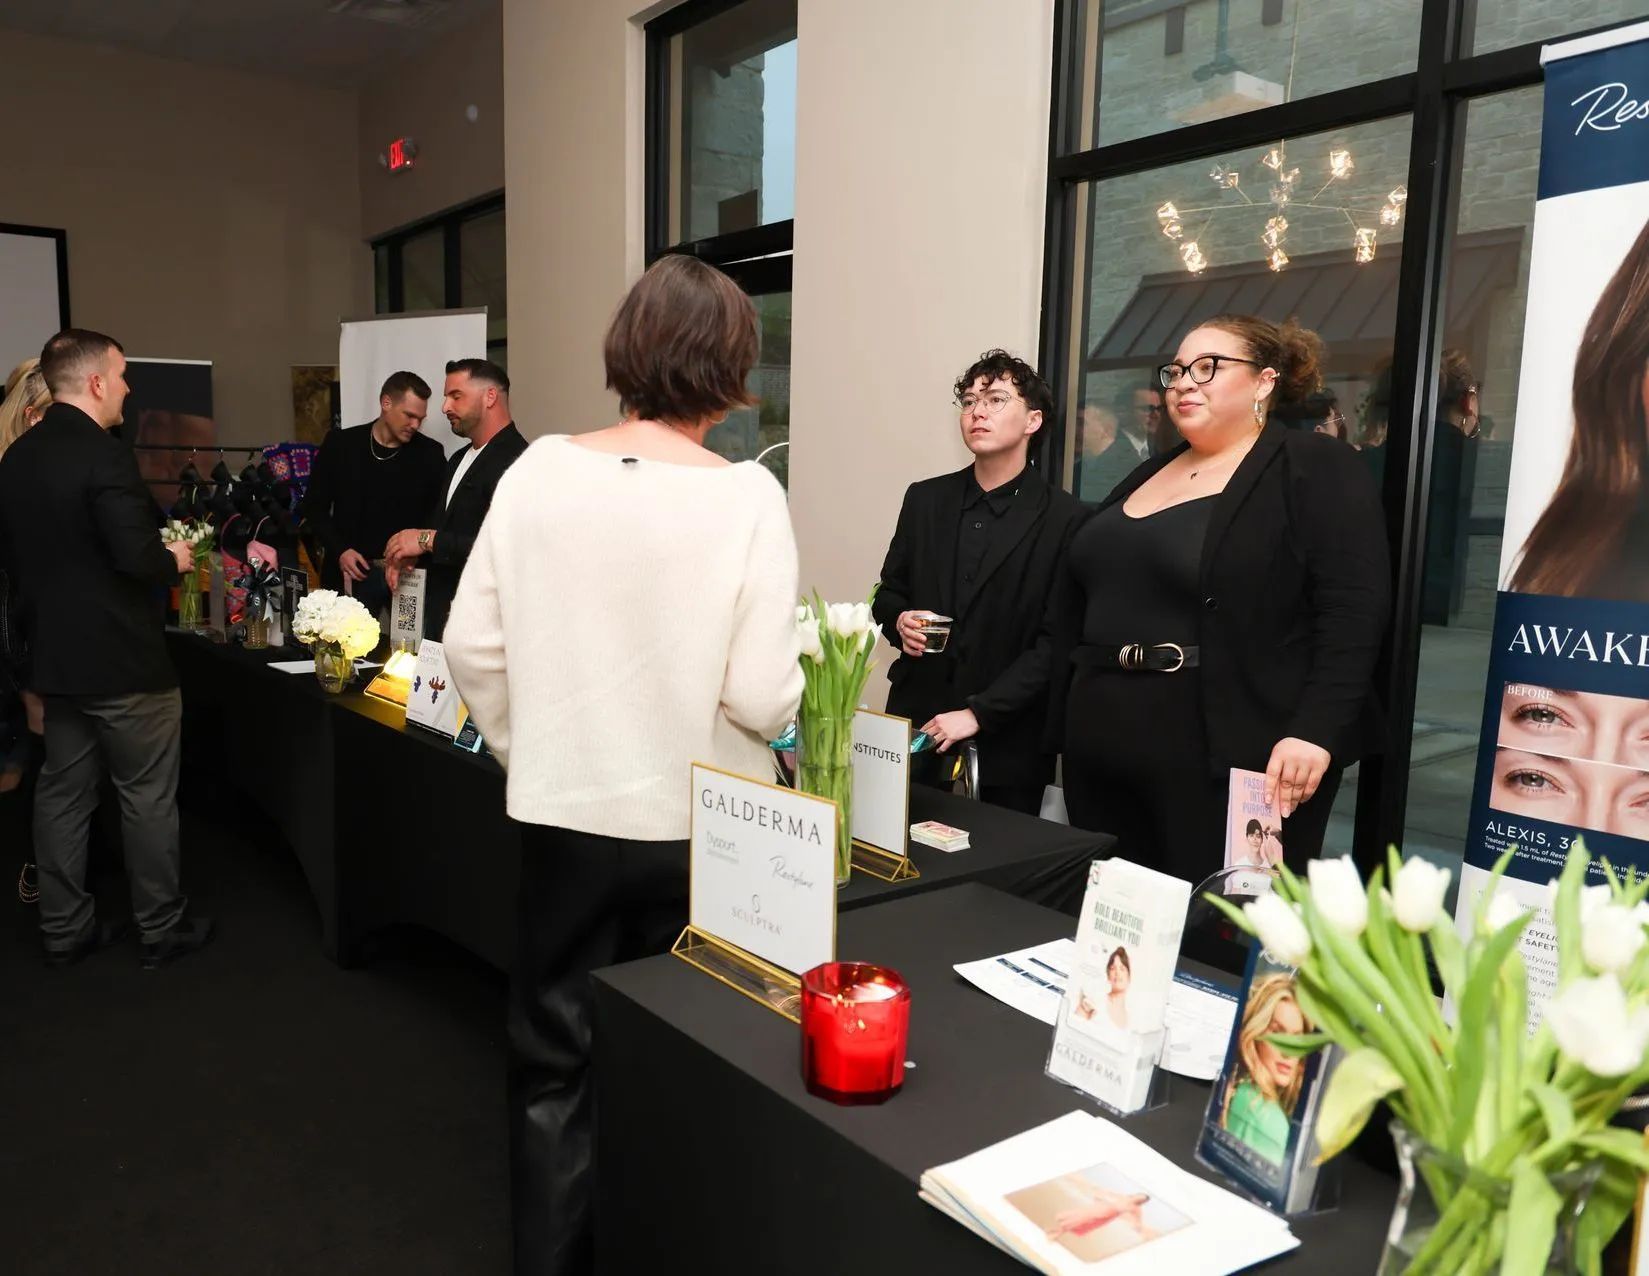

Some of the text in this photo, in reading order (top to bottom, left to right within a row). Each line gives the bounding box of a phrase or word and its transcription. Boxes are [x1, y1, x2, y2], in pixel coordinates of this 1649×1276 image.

[390, 138, 404, 169] EXIT
[1507, 684, 1553, 700] BEFORE
[701, 788, 822, 846] GALDERMA
[1243, 802, 1273, 818] PURPOSE
[706, 829, 736, 852] Dysport
[1485, 820, 1551, 848] ALEXIS,
[1485, 835, 1505, 846] Treated
[1484, 842, 1496, 850] Two
[1515, 852, 1530, 860] after
[730, 906, 782, 936] SCULPTRA
[1094, 901, 1144, 933] BOLD BEAUTIFUL
[1128, 931, 1142, 947] YOU
[1055, 1042, 1123, 1086] GALDERMA
